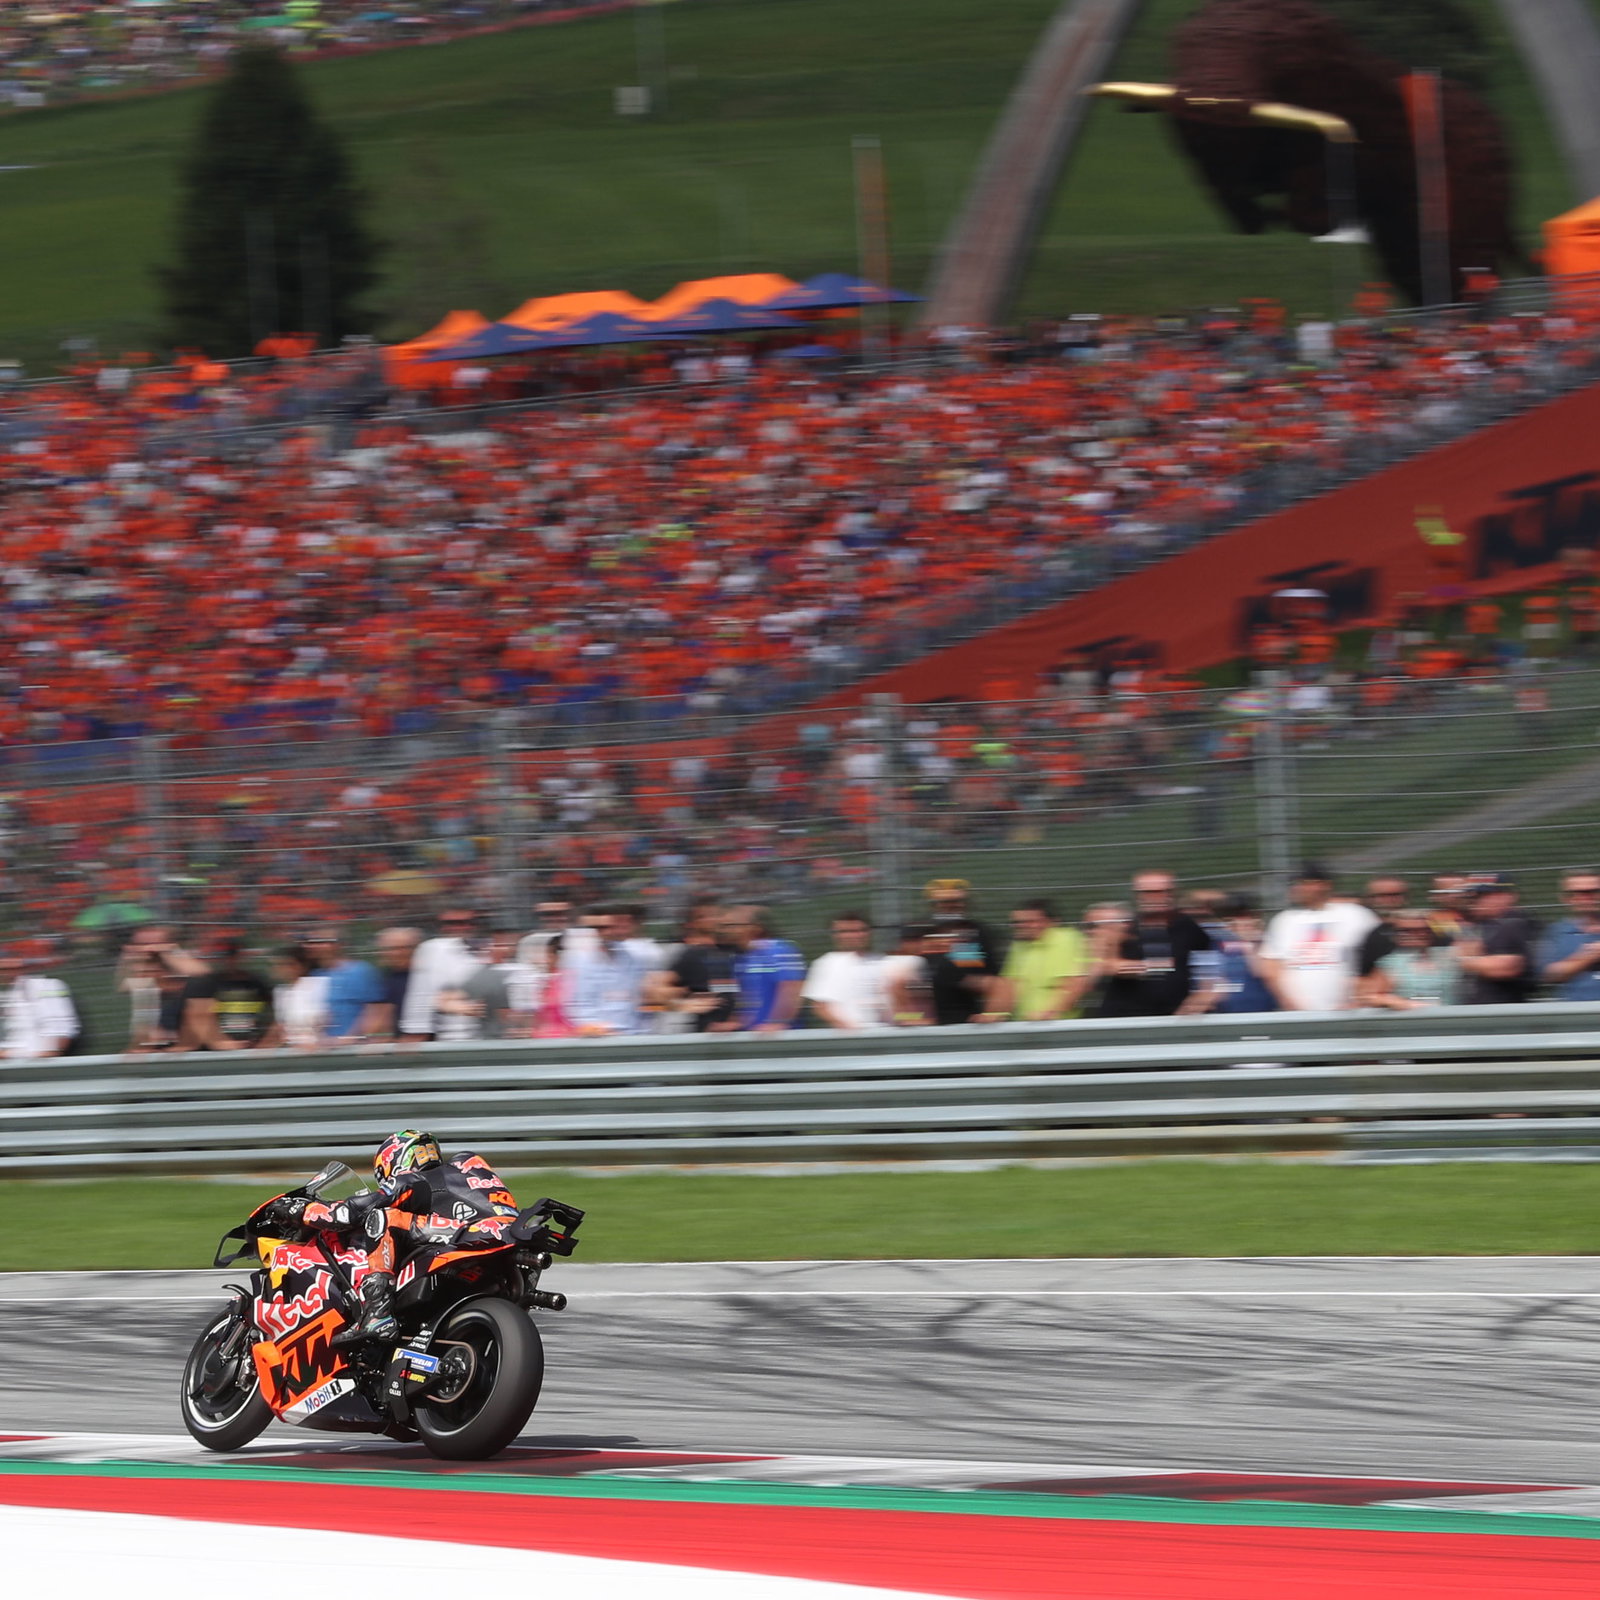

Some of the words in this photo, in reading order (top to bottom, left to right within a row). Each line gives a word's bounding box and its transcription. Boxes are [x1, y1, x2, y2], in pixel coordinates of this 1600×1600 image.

[466, 1174, 505, 1190] Red
[254, 1269, 333, 1341] Red
[269, 1316, 347, 1409] KTM
[304, 1386, 333, 1413] Mobil
[330, 1380, 342, 1396] 1
